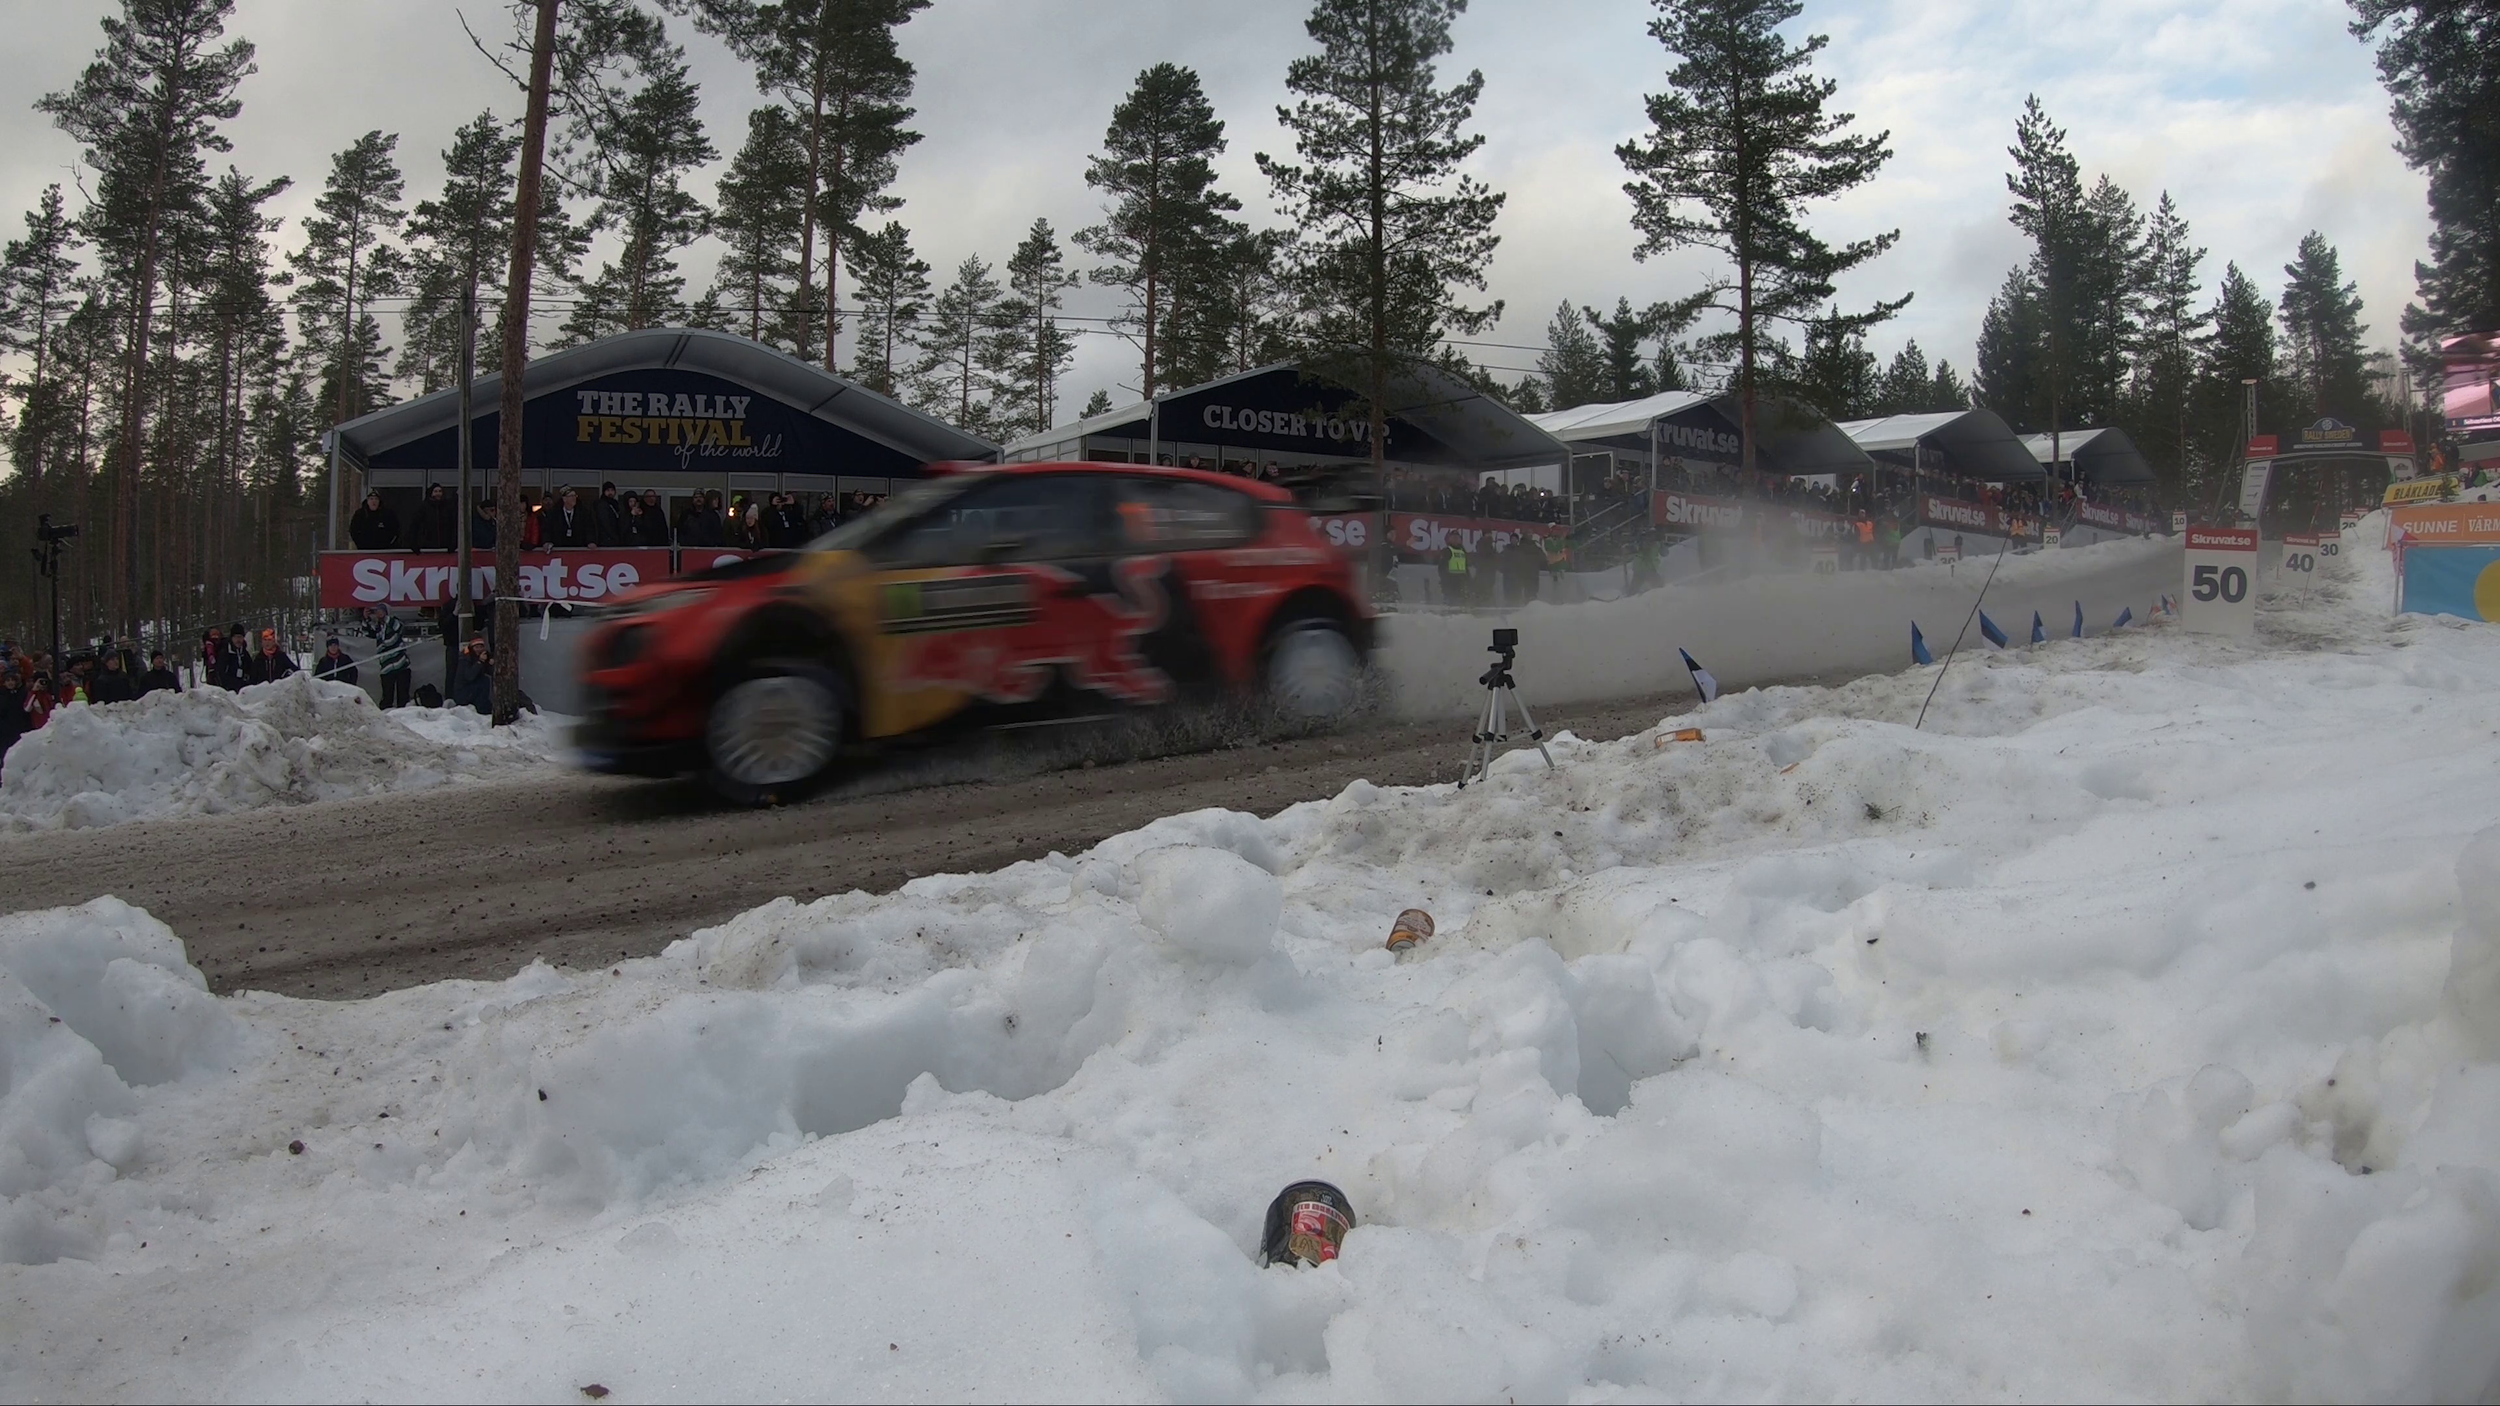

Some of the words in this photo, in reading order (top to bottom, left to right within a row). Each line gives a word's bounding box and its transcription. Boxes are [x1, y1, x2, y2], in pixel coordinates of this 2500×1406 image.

[577, 390, 642, 417] THE
[647, 392, 751, 419] RALLY
[576, 415, 752, 446] FESTIVAL
[1202, 404, 1307, 437] CLOSER
[1312, 416, 1347, 440] TO
[674, 432, 695, 470] of
[699, 433, 729, 457] the
[732, 433, 783, 458] world
[1928, 497, 1986, 527] Skruvat.se
[2174, 517, 2185, 525] 10
[2046, 535, 2059, 544] 20
[2191, 533, 2252, 546] Skruvat.se
[2403, 520, 2458, 534] SUNNE
[2320, 543, 2339, 556] 30
[2285, 552, 2315, 573] 40
[2191, 564, 2248, 604] 50
